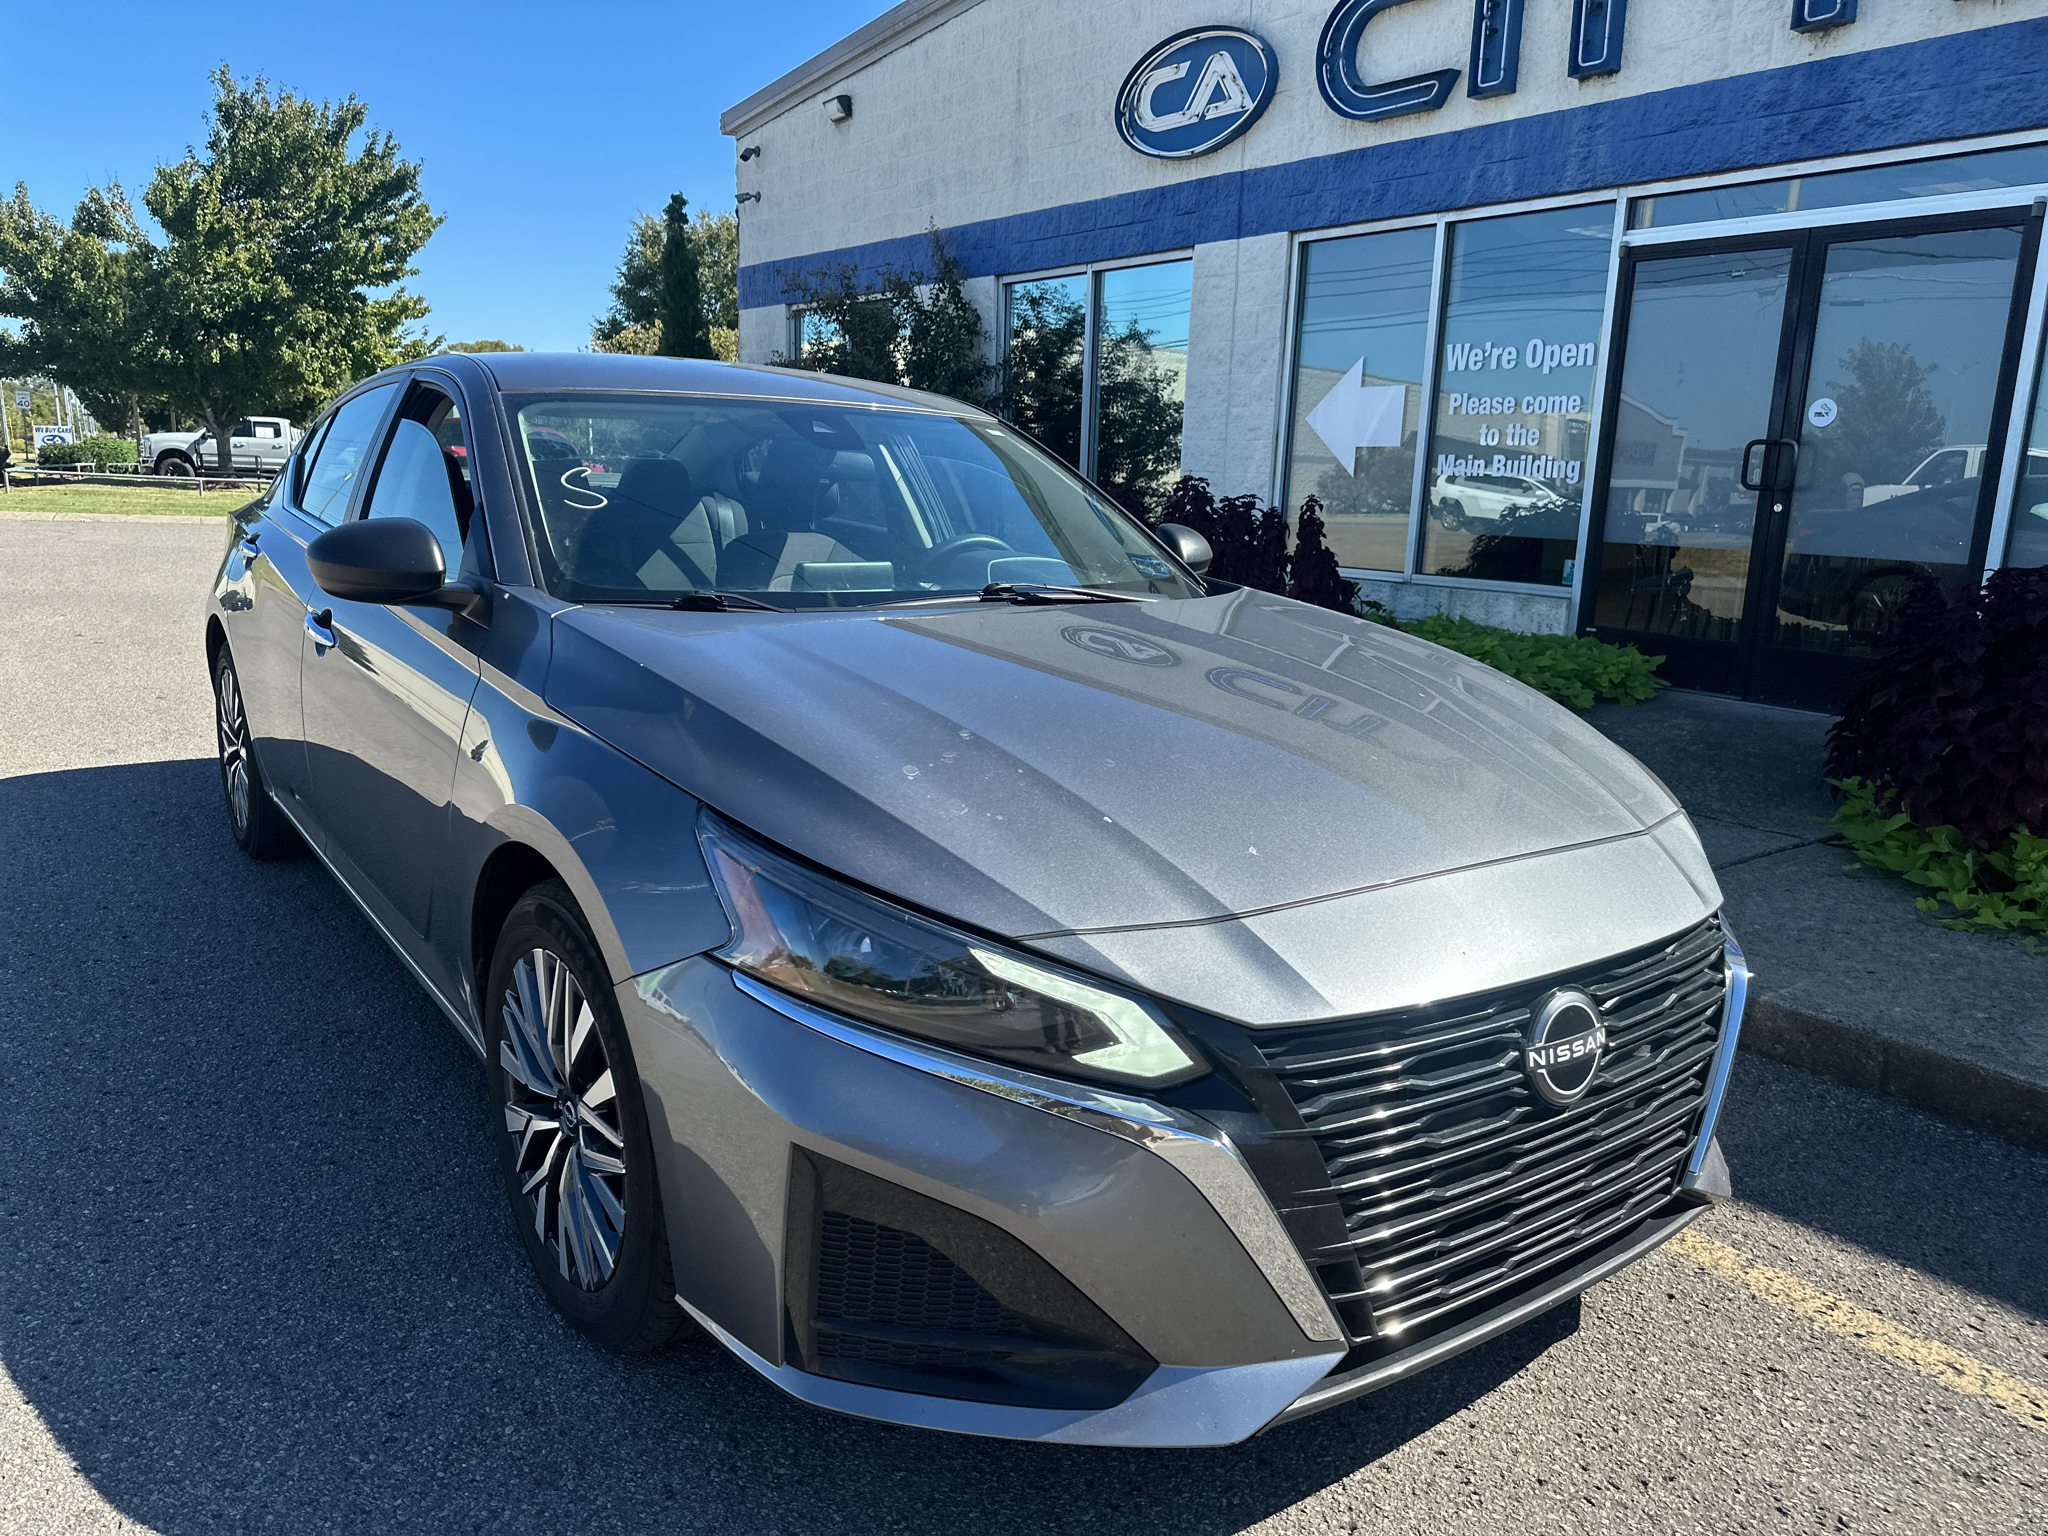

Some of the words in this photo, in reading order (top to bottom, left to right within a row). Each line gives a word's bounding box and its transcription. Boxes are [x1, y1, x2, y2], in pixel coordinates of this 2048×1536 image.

[1132, 50, 1251, 133] CA
[1446, 341, 1518, 372] We're
[1525, 338, 1596, 375] Open
[17, 400, 30, 408] 40
[1448, 392, 1516, 416] Please
[1521, 394, 1582, 415] come
[57, 426, 72, 434] CARS
[1479, 423, 1500, 447] to
[1505, 422, 1540, 447] the
[1436, 454, 1486, 477] Main
[1491, 454, 1581, 484] Building
[1528, 1027, 1606, 1068] NISSAN
